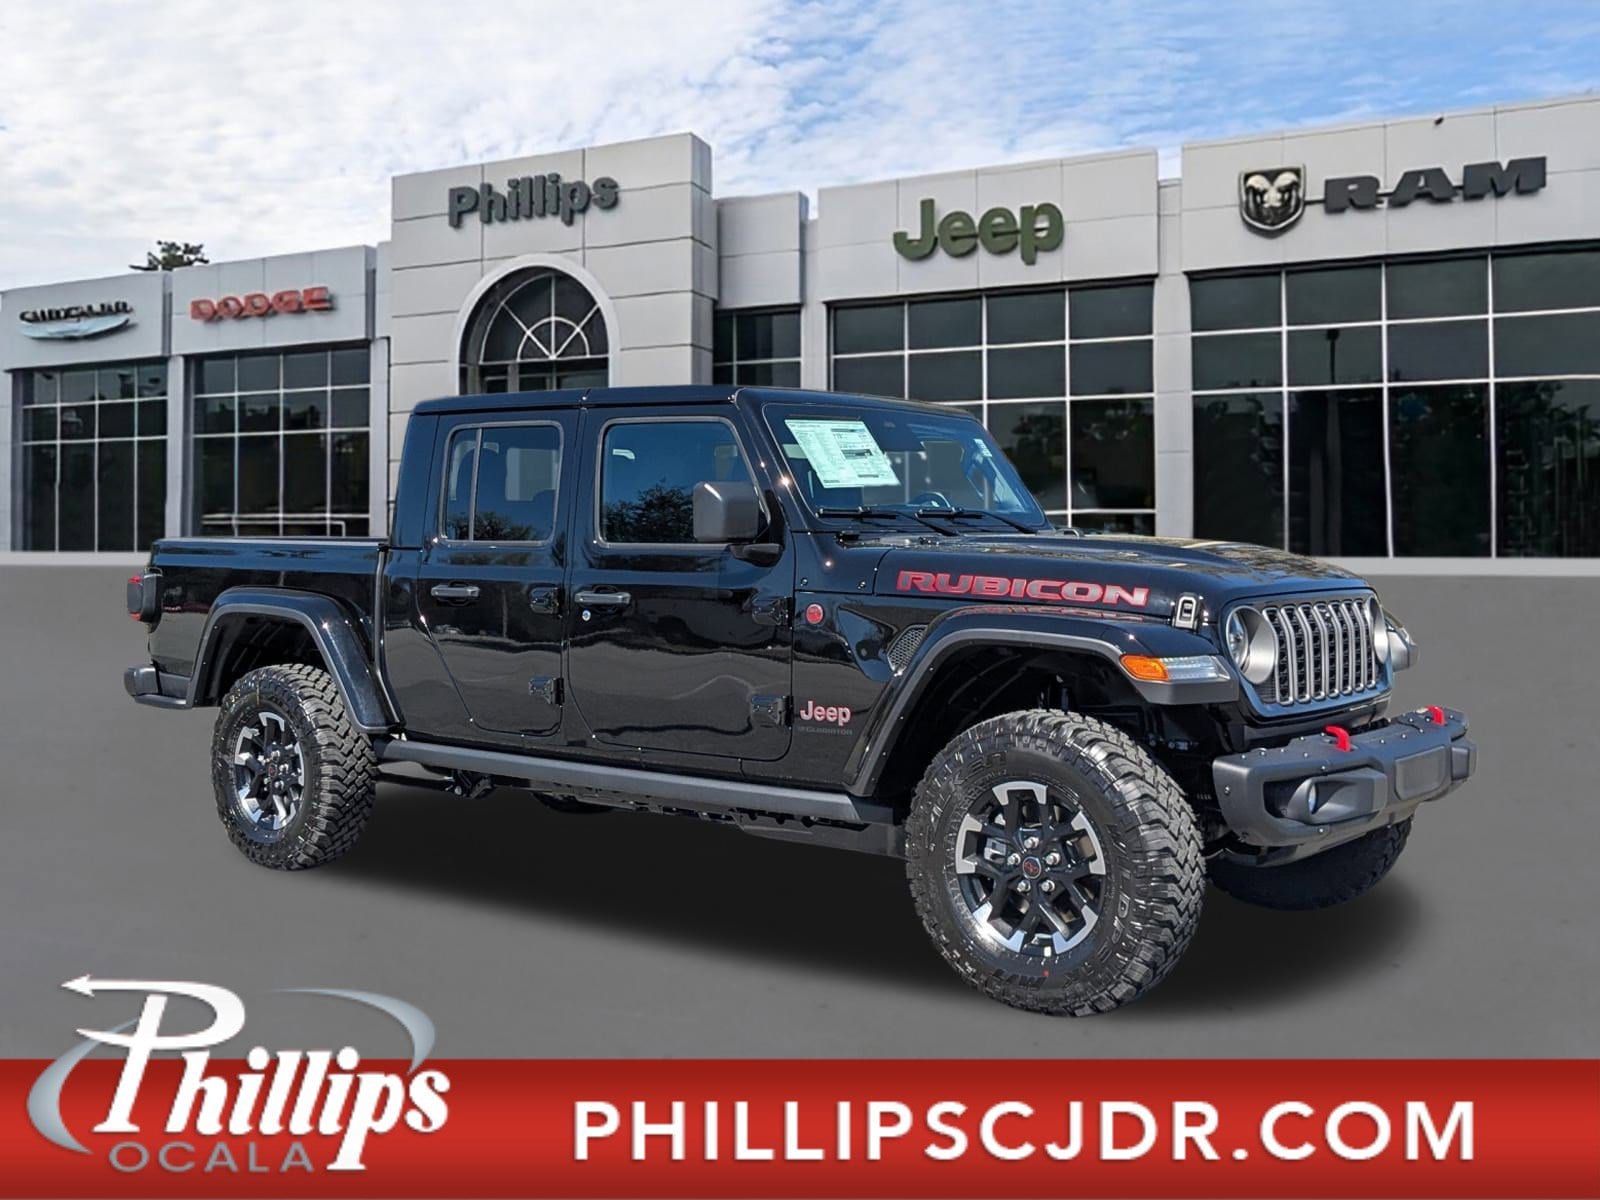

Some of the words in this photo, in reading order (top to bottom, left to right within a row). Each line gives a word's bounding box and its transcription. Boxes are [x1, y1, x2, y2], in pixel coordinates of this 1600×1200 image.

[448, 173, 620, 228] Phillips
[1324, 156, 1547, 214] RAM
[893, 198, 1064, 266] Jeep
[190, 286, 335, 321] DODGE
[896, 570, 1150, 607] RUBICON
[799, 700, 851, 726] Jeep
